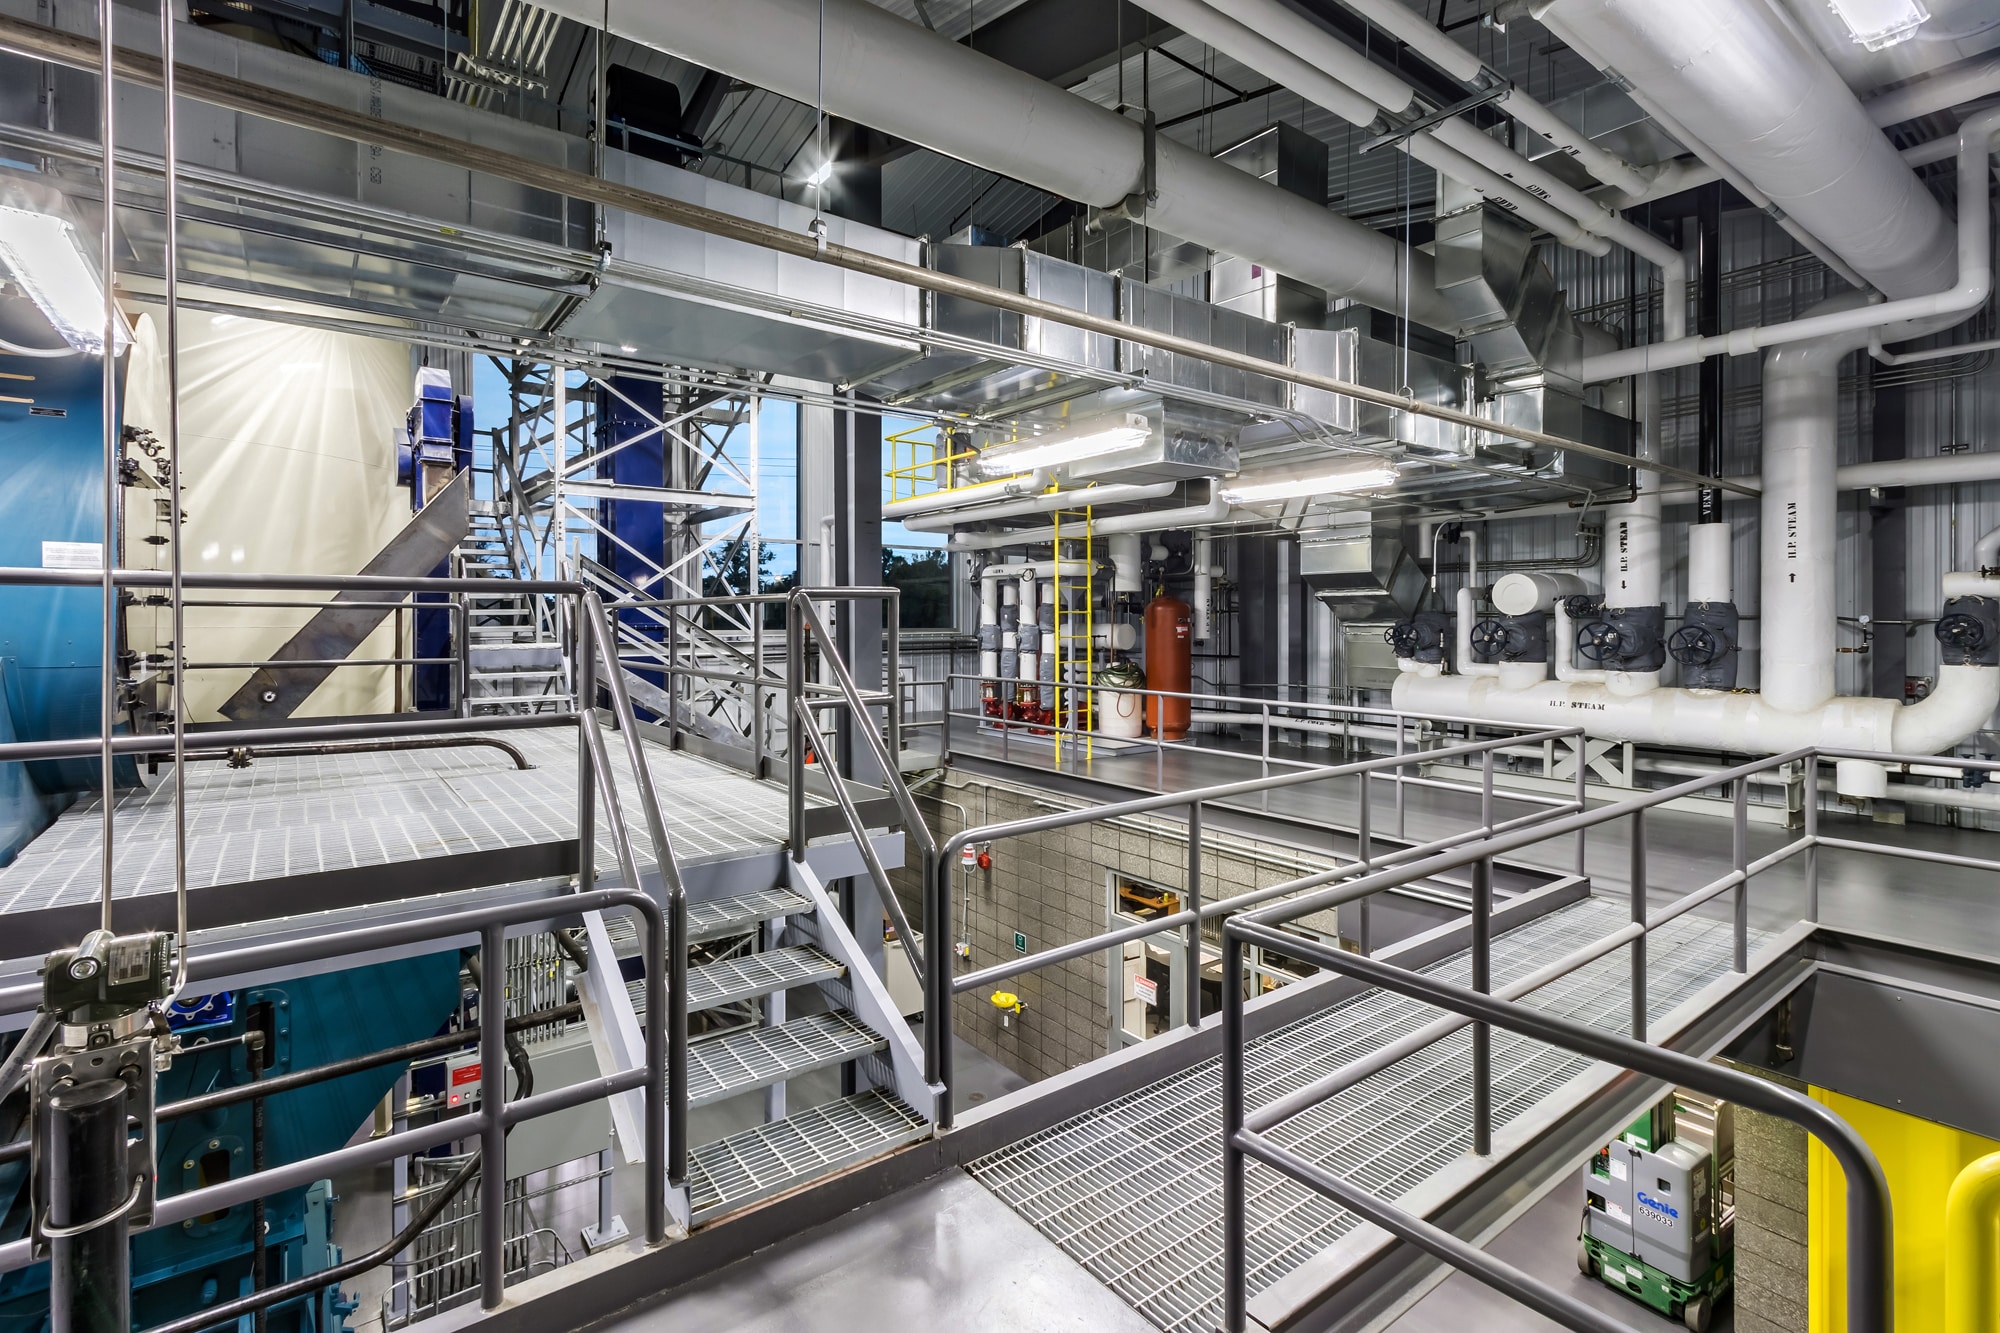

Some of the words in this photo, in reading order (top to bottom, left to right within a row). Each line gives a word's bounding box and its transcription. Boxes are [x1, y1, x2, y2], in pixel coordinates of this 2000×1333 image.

[1702, 489, 1711, 515] VENT
[1787, 502, 1797, 537] STEAM
[1619, 521, 1628, 553] STEAM
[1571, 701, 1605, 710] STEAM
[1637, 1191, 1679, 1219] Genie
[1639, 1206, 1674, 1228] 639033
